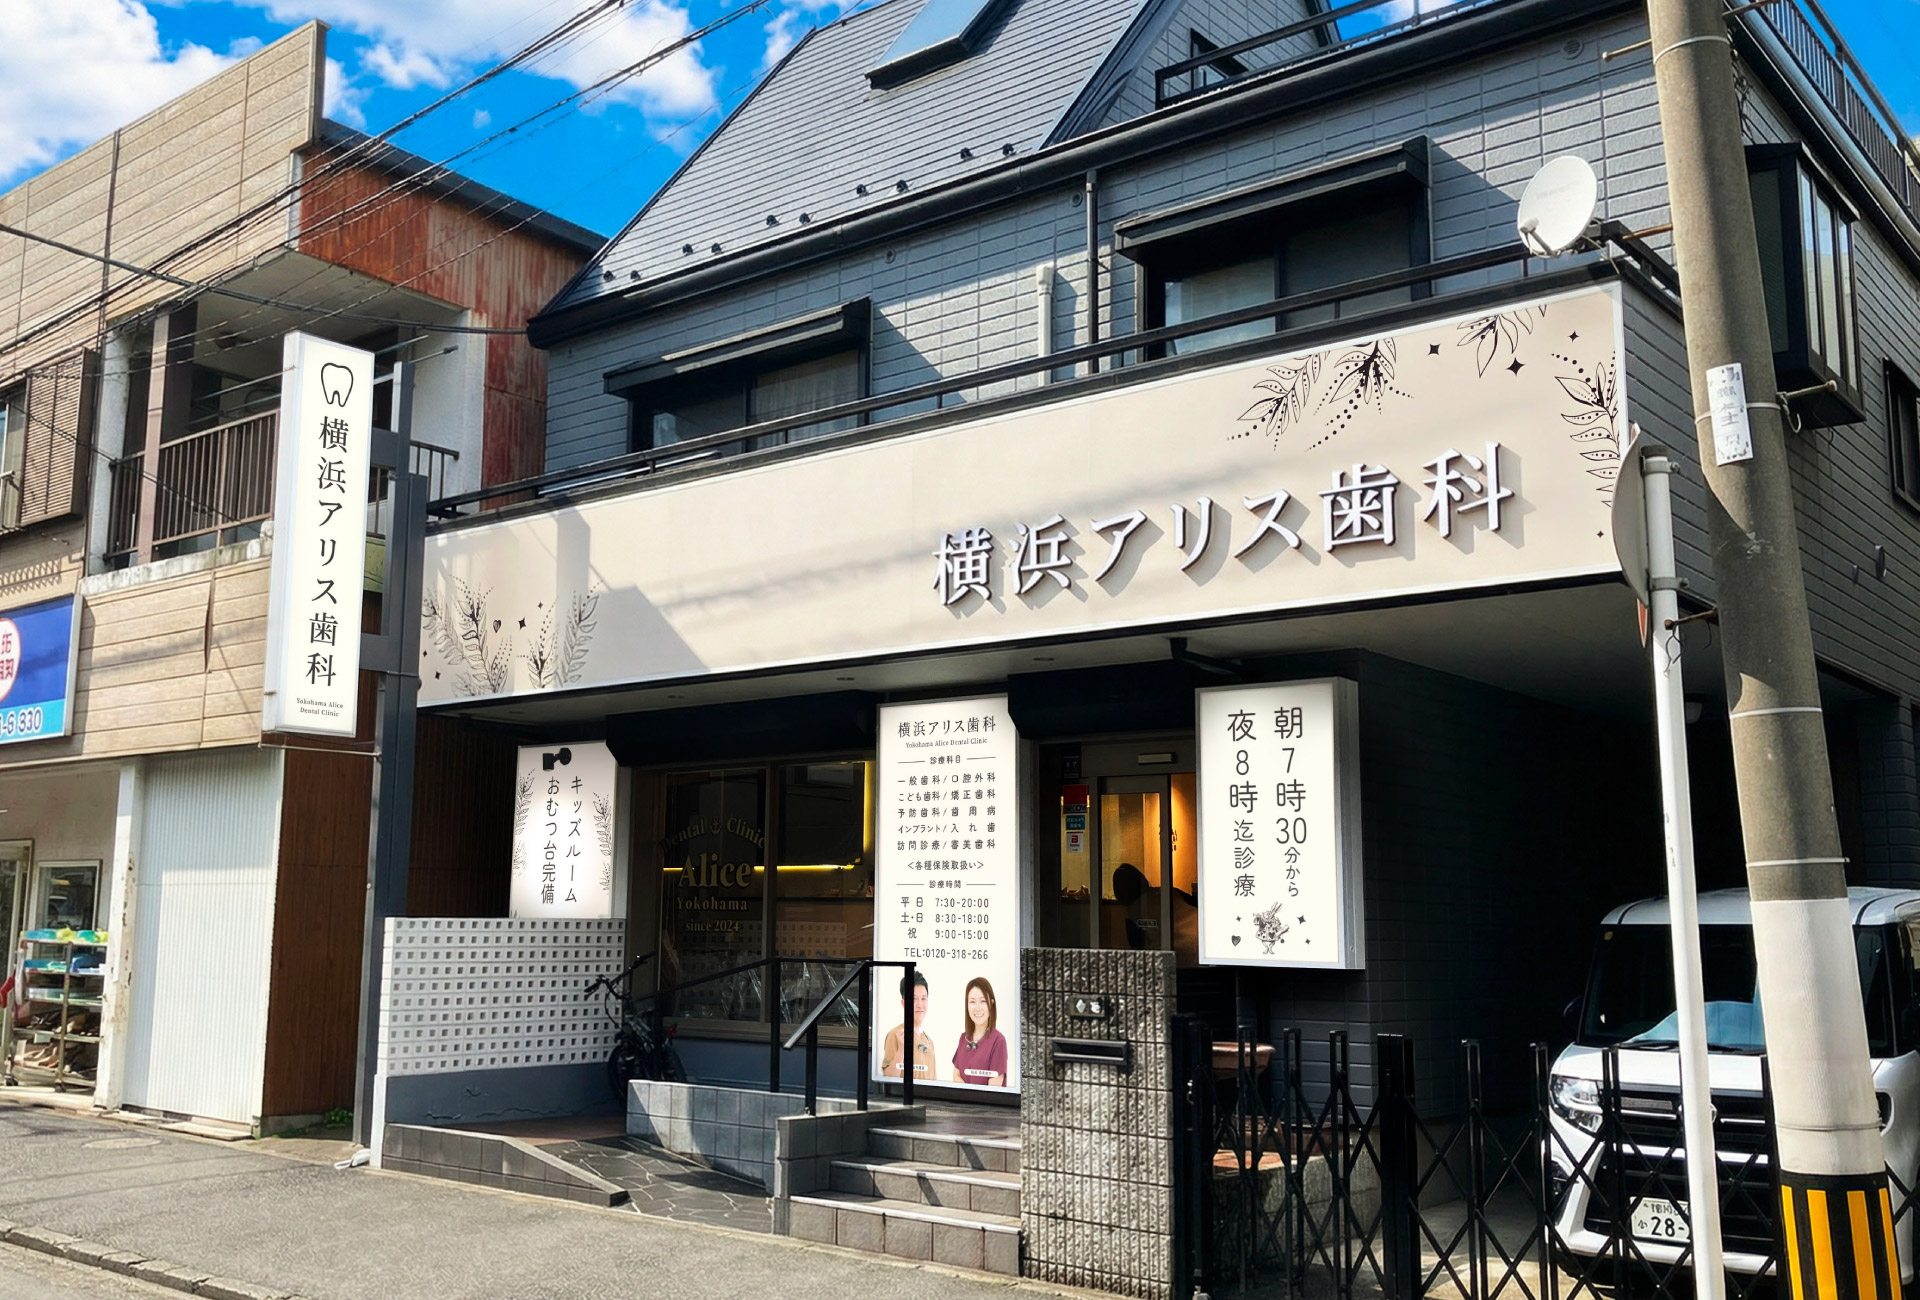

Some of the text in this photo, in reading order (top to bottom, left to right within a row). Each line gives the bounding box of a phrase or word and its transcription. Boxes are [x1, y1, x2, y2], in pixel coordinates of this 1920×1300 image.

[932, 441, 1515, 607] 横浜アリス歯科
[306, 416, 349, 687] 横浜アリス歯科
[296, 697, 327, 707] Yokohama
[300, 707, 340, 717] Dental Clinic
[898, 715, 996, 738] 横浜アリス歯科
[905, 741, 934, 749] Yokohama
[950, 738, 969, 746] Dental
[970, 737, 988, 745] Clinic
[929, 755, 961, 765] 診療科目
[1227, 709, 1259, 897] 夜8時迄診療
[1274, 706, 1307, 897] 朝7時30分から
[727, 816, 765, 848] Clinic
[541, 776, 560, 904] おむつ台完備
[565, 776, 583, 903] キッズルーム
[677, 852, 752, 888] Alice
[929, 880, 961, 888] 診療時間
[677, 896, 748, 911] Yokohama
[935, 898, 989, 908] 7:30-20:00
[685, 919, 740, 932] since 2024
[935, 913, 989, 924] 8:30-18:00
[907, 927, 989, 940] 祝 9:00-15:00
[904, 948, 988, 960] TEL:0120-318-266
